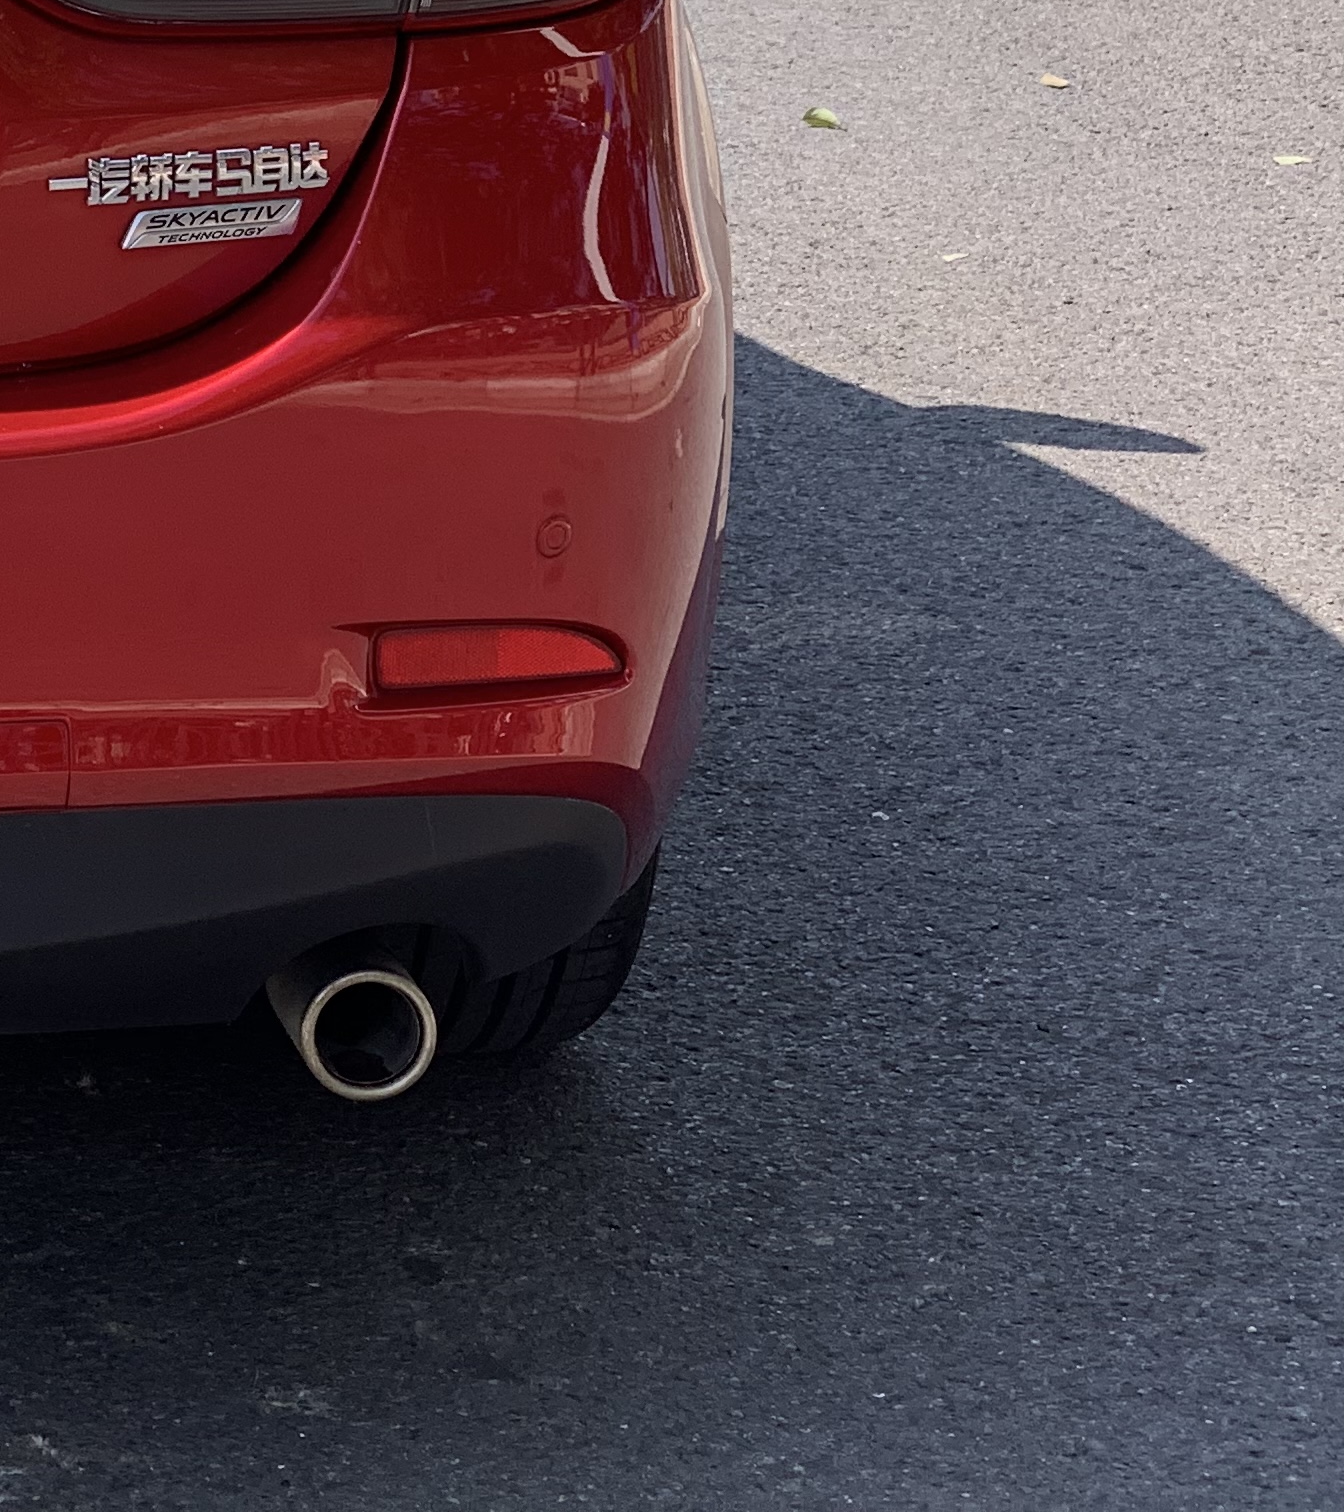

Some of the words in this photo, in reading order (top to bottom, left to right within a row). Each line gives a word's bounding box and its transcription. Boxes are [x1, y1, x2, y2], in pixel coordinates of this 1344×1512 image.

[48, 142, 330, 206] 一汽轿车马自达
[147, 204, 285, 229] SKYACTIV
[158, 226, 267, 244] TECHNOLOGY
